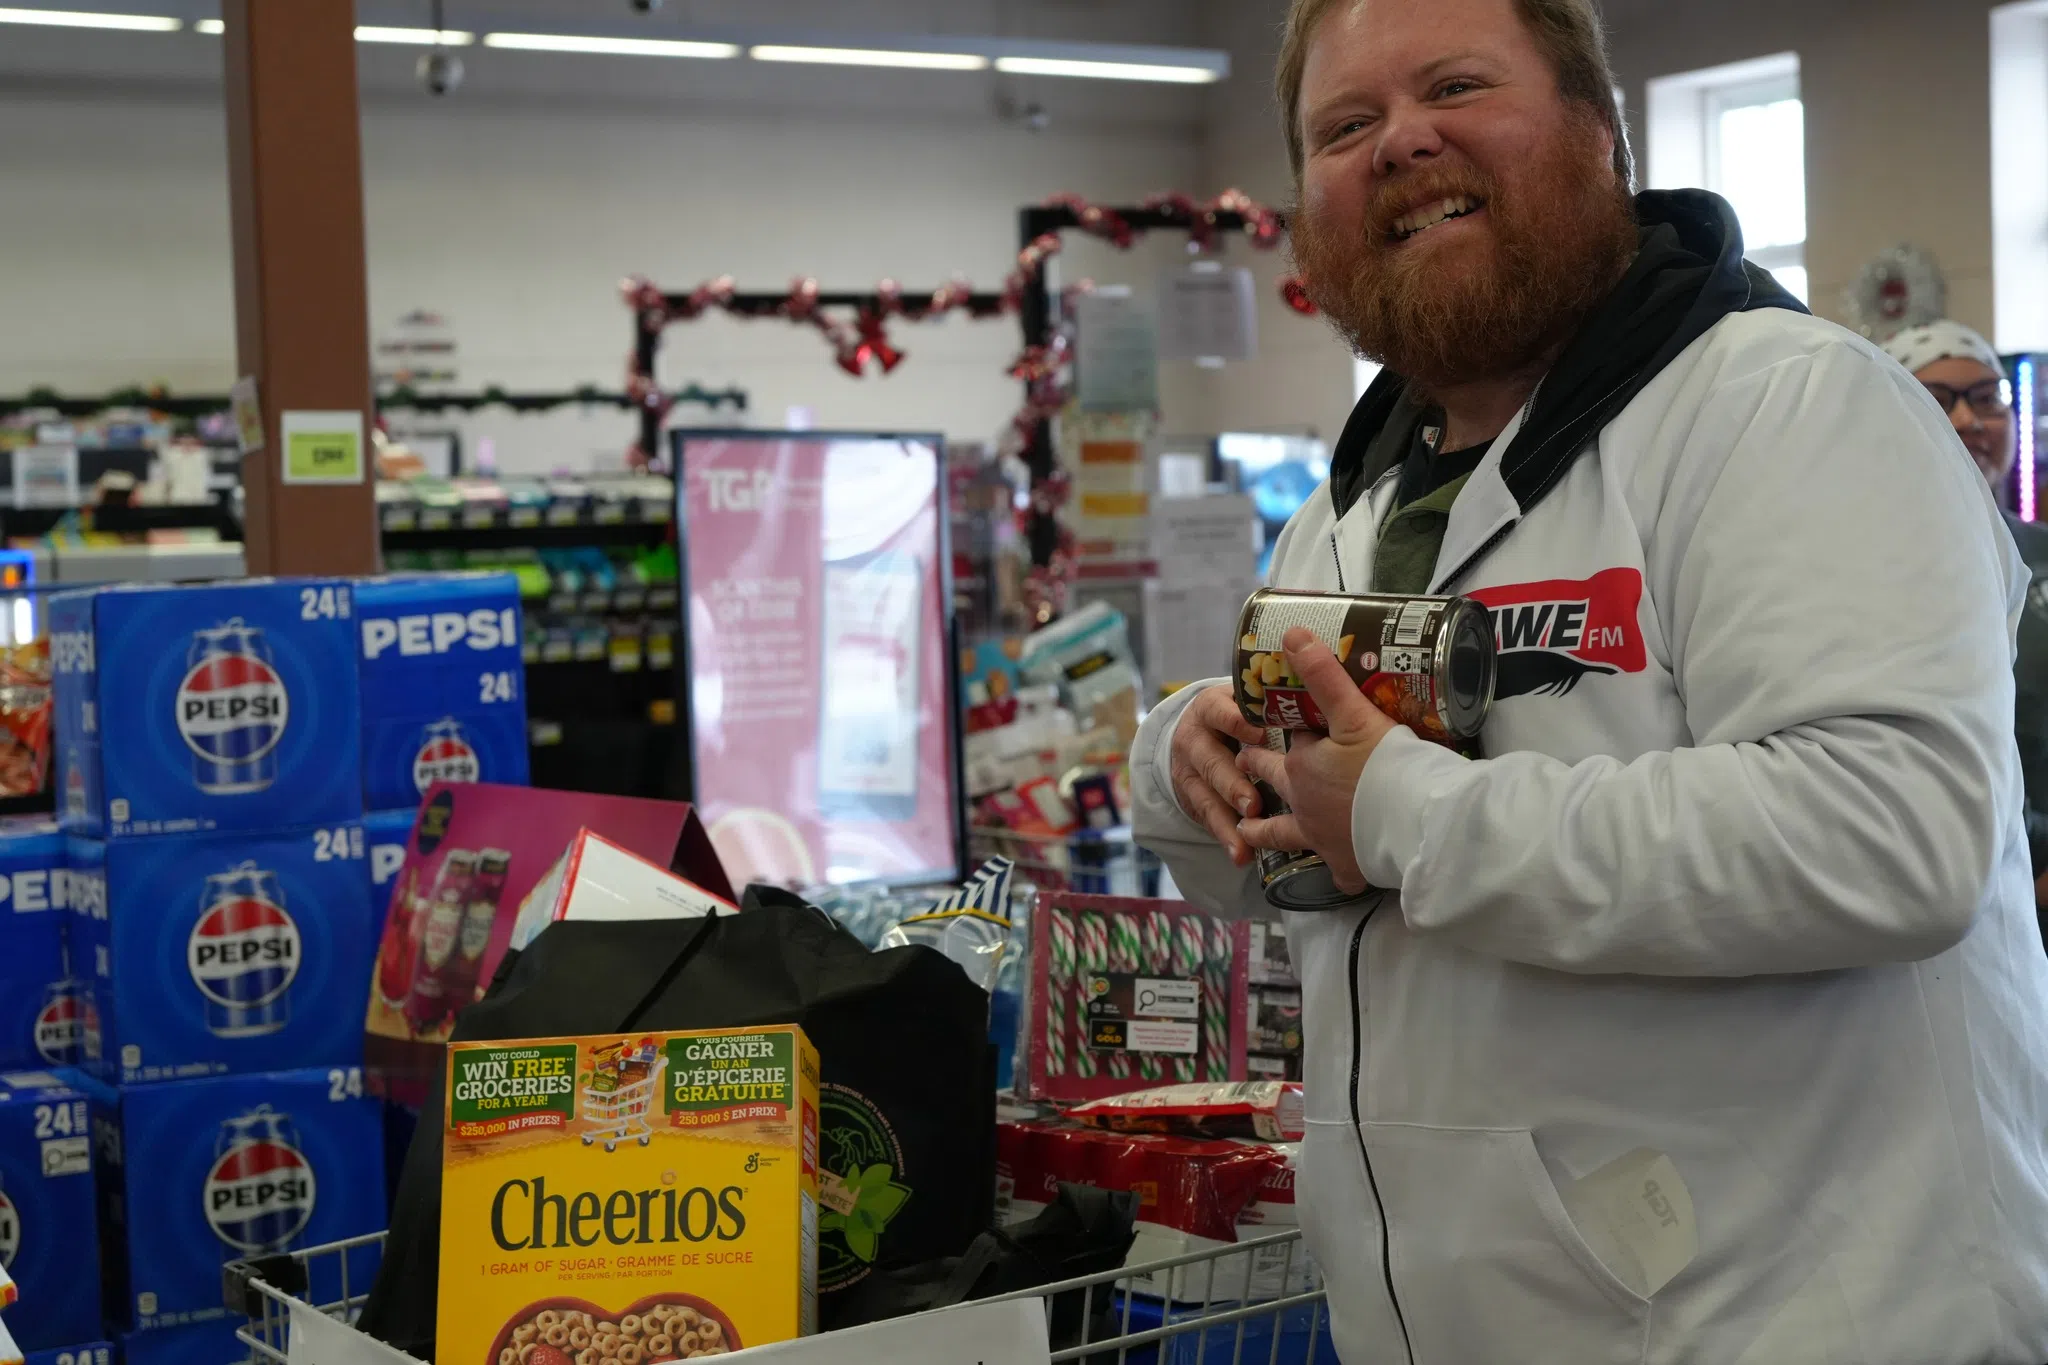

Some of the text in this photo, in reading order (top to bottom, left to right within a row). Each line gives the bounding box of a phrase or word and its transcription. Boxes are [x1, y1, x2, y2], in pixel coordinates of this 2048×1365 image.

[301, 588, 334, 620] 24
[361, 608, 516, 659] PEPSI
[1588, 626, 1624, 649] FM
[50, 633, 95, 673] PEPSI
[479, 671, 510, 704] 24
[184, 696, 279, 721] PEPSI
[419, 763, 472, 780] PEPSI
[314, 829, 349, 861] 24
[196, 940, 292, 967] PEPSI
[696, 1035, 765, 1045] VOUS POURRIEZ
[1095, 1033, 1123, 1044] GOLD
[489, 1050, 540, 1061] YOU COULD
[686, 1042, 774, 1060] GAGNER
[462, 1061, 509, 1081] WIN
[711, 1059, 750, 1069] UN AN
[327, 1068, 362, 1102] 24
[456, 1075, 572, 1101] GROCERIES
[674, 1067, 785, 1087] D'ÉPICERIE
[477, 1095, 548, 1110] FOR A YEAR!
[675, 1083, 785, 1103] GRATUITE
[34, 1104, 72, 1138] 24
[460, 1115, 560, 1137] $250,000 IN PRIZES!
[679, 1106, 777, 1125] 250 000 $ EN PRIX!
[212, 1184, 307, 1211] PEPSI
[491, 1169, 746, 1252] Cheerios
[490, 1263, 529, 1275] GRAM
[534, 1261, 554, 1272] OF
[559, 1257, 605, 1271] SUGAR
[616, 1255, 675, 1269] GRAMME
[682, 1254, 700, 1266] DE
[706, 1252, 754, 1264] SUCRE
[576, 1272, 610, 1280] SERVING
[617, 1271, 634, 1279] PAR
[636, 1269, 673, 1278] PORTION
